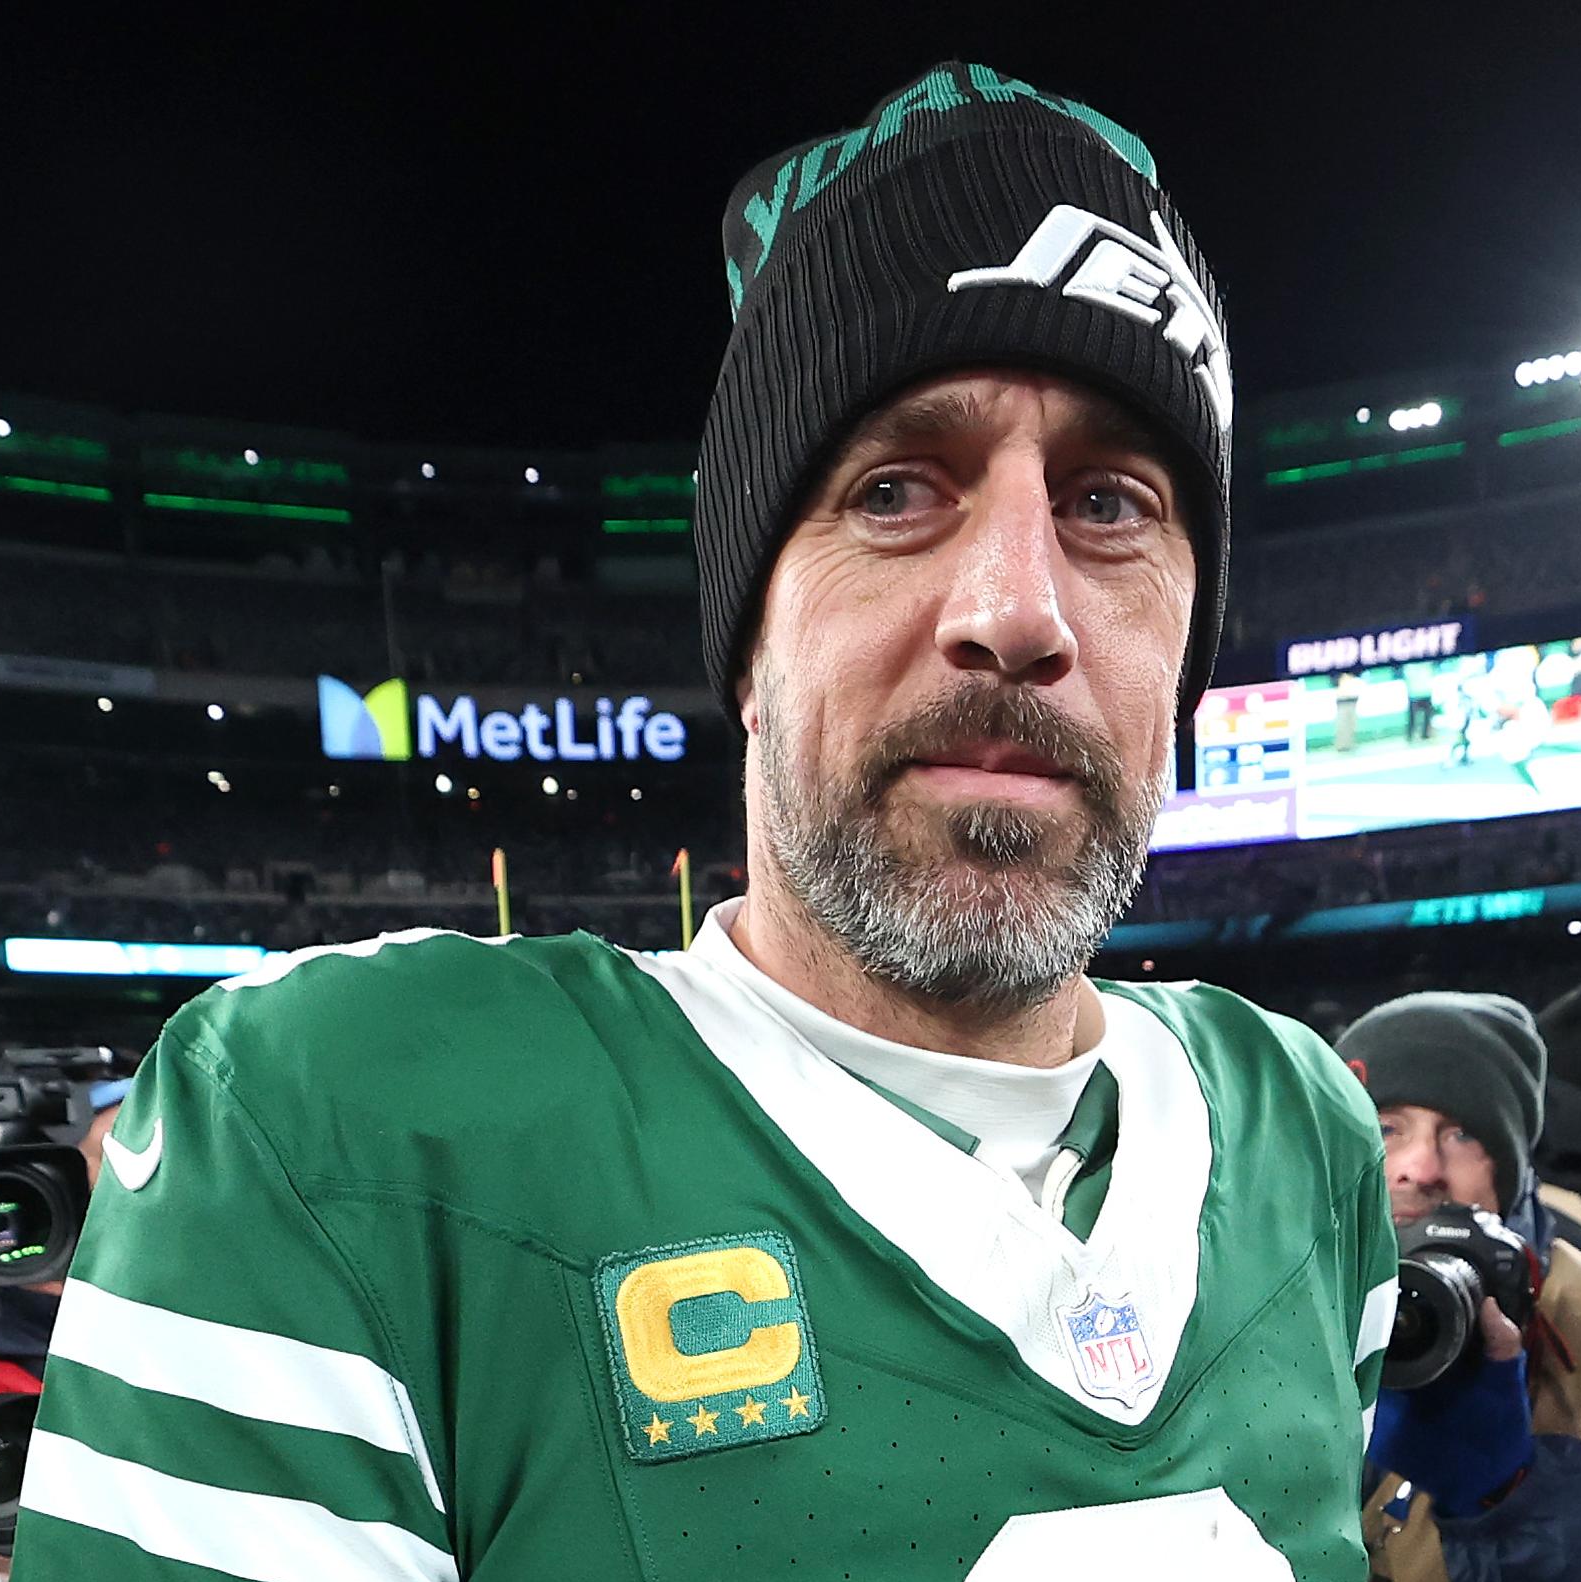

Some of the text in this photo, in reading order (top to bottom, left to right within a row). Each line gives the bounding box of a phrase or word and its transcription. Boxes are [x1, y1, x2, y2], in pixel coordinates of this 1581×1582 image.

[1288, 622, 1462, 675] BUD LIGHT
[418, 694, 686, 761] MetLife
[616, 1247, 801, 1403] C
[1082, 1329, 1150, 1381] NFL
